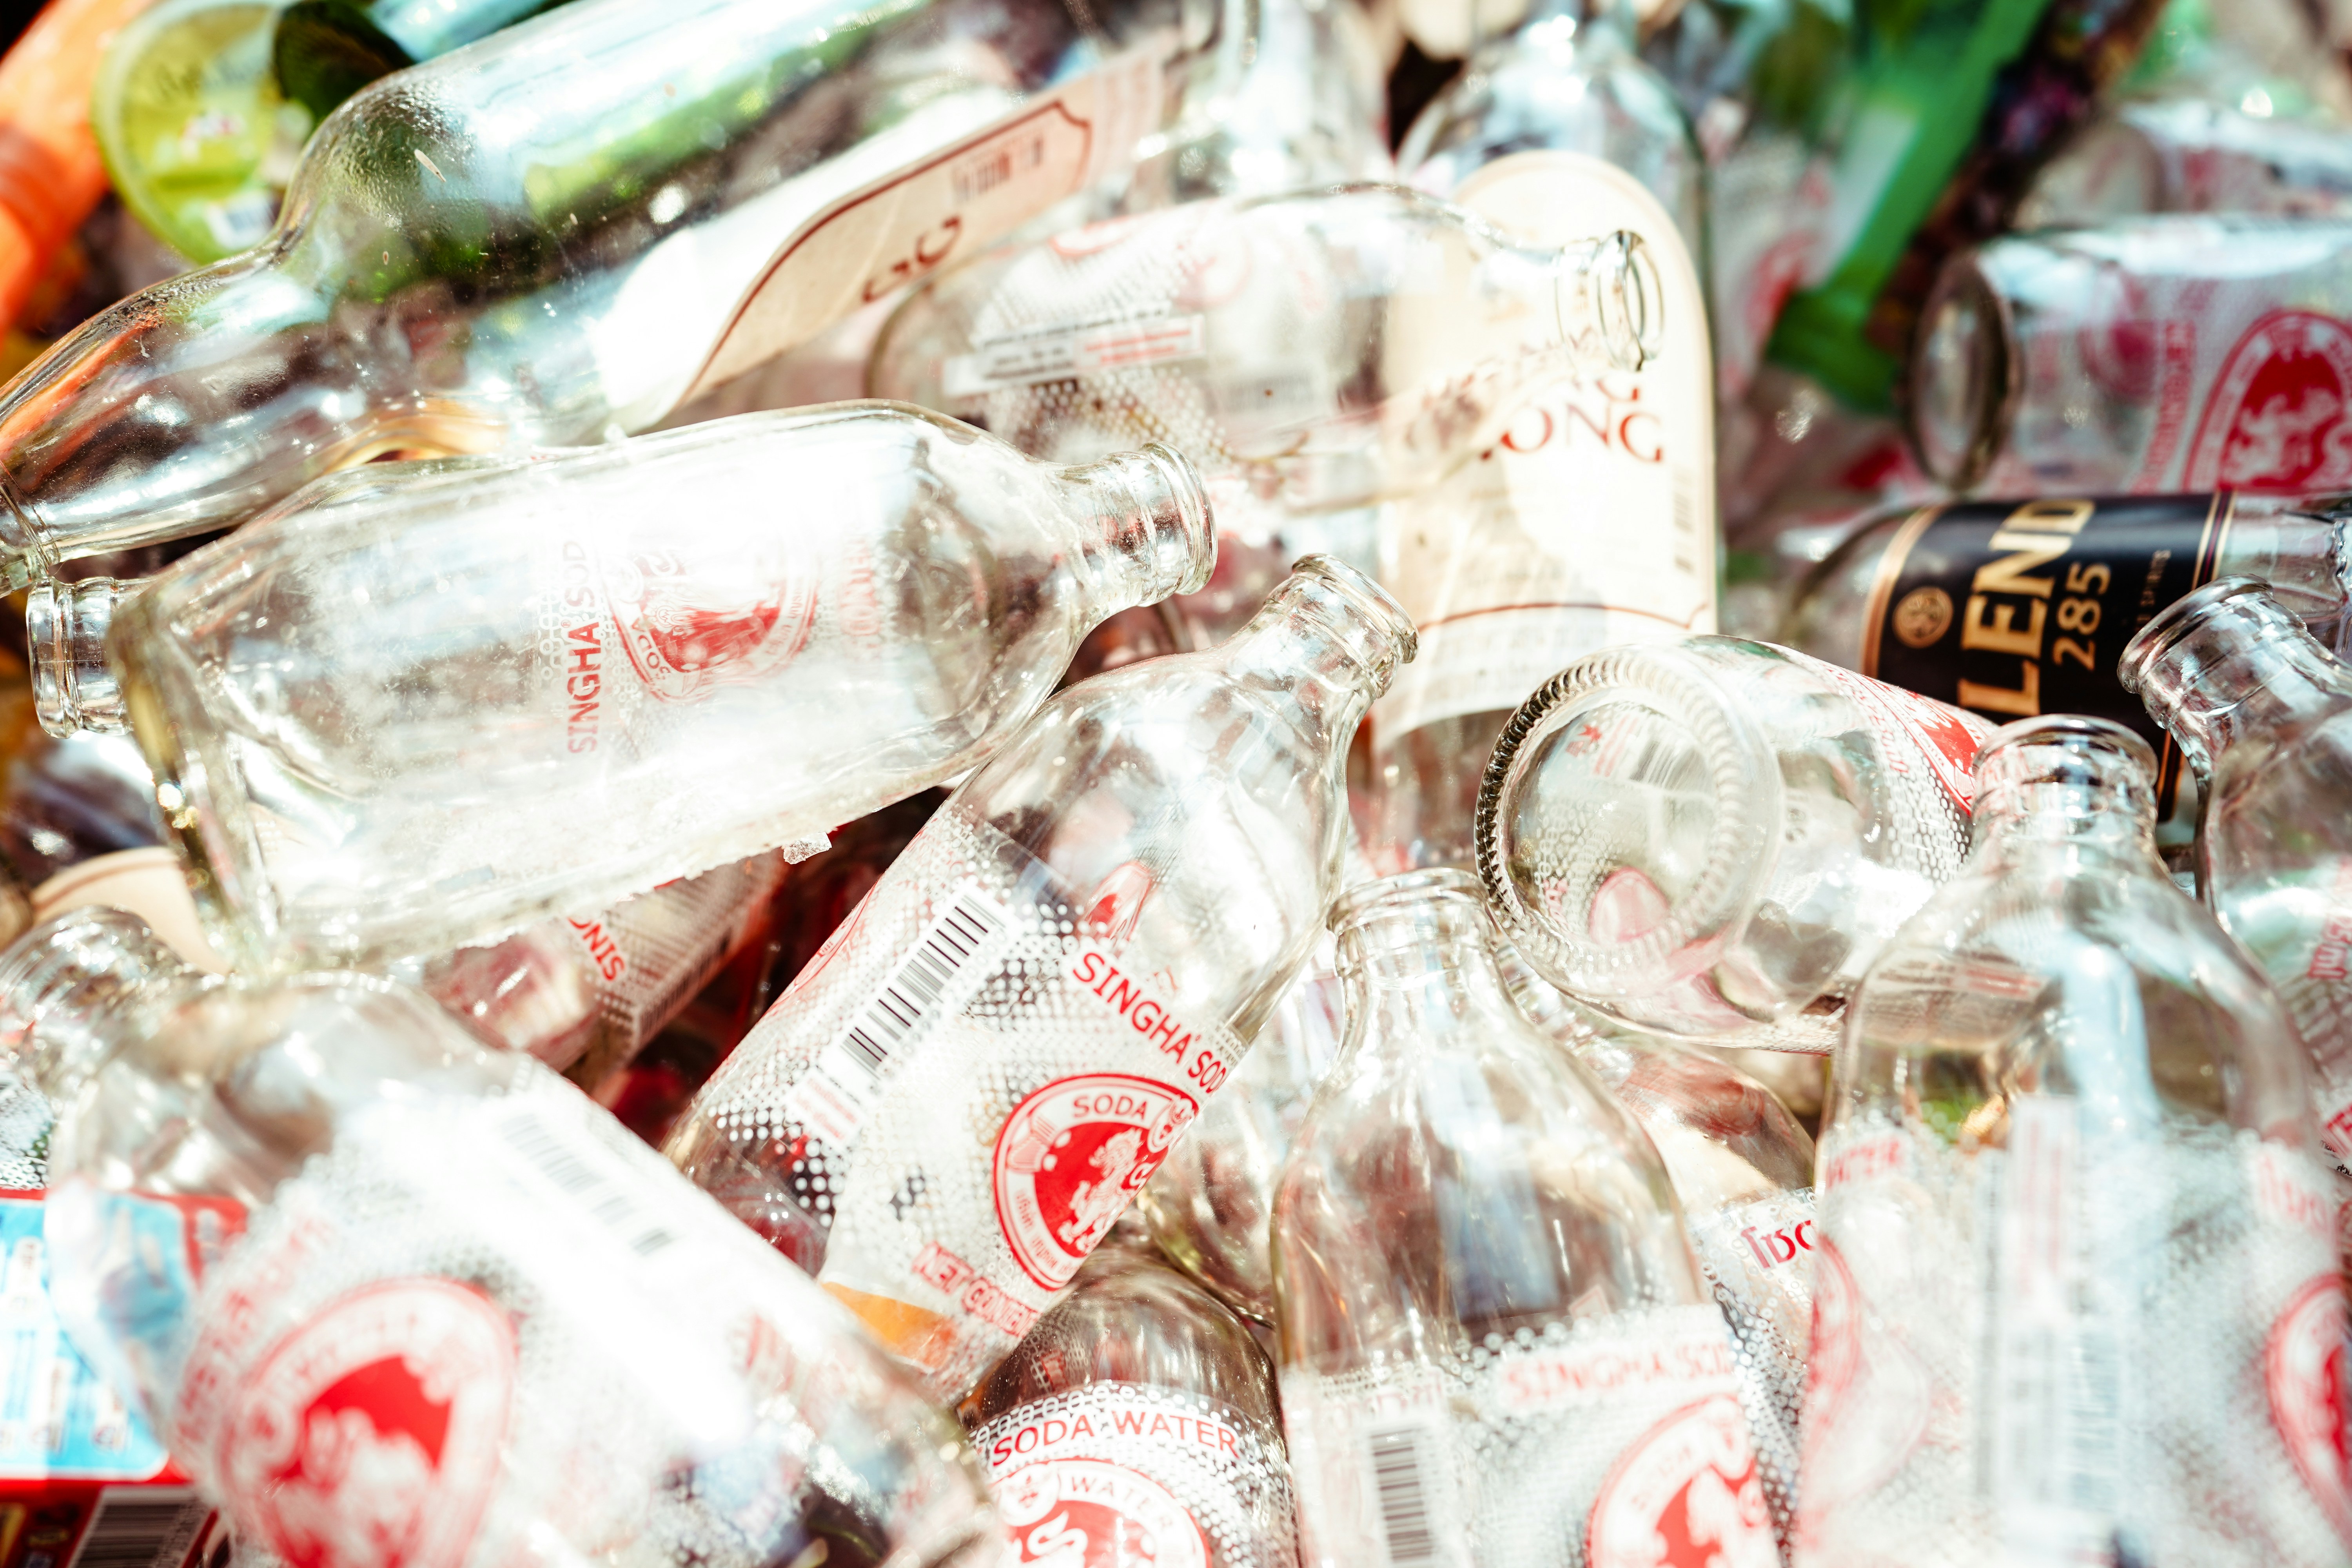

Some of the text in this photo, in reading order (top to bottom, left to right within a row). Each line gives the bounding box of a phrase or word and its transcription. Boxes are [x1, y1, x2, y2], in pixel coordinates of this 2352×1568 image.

[1480, 399, 1665, 464] ONG
[562, 539, 596, 608] SOD
[1958, 498, 2097, 717] LEND
[2053, 561, 2112, 672] 285
[1073, 952, 1227, 1094] SINGHA SOD
[1073, 1094, 1148, 1121] SODA
[911, 1240, 975, 1294] NET
[992, 1410, 1241, 1467] SODA WATER
